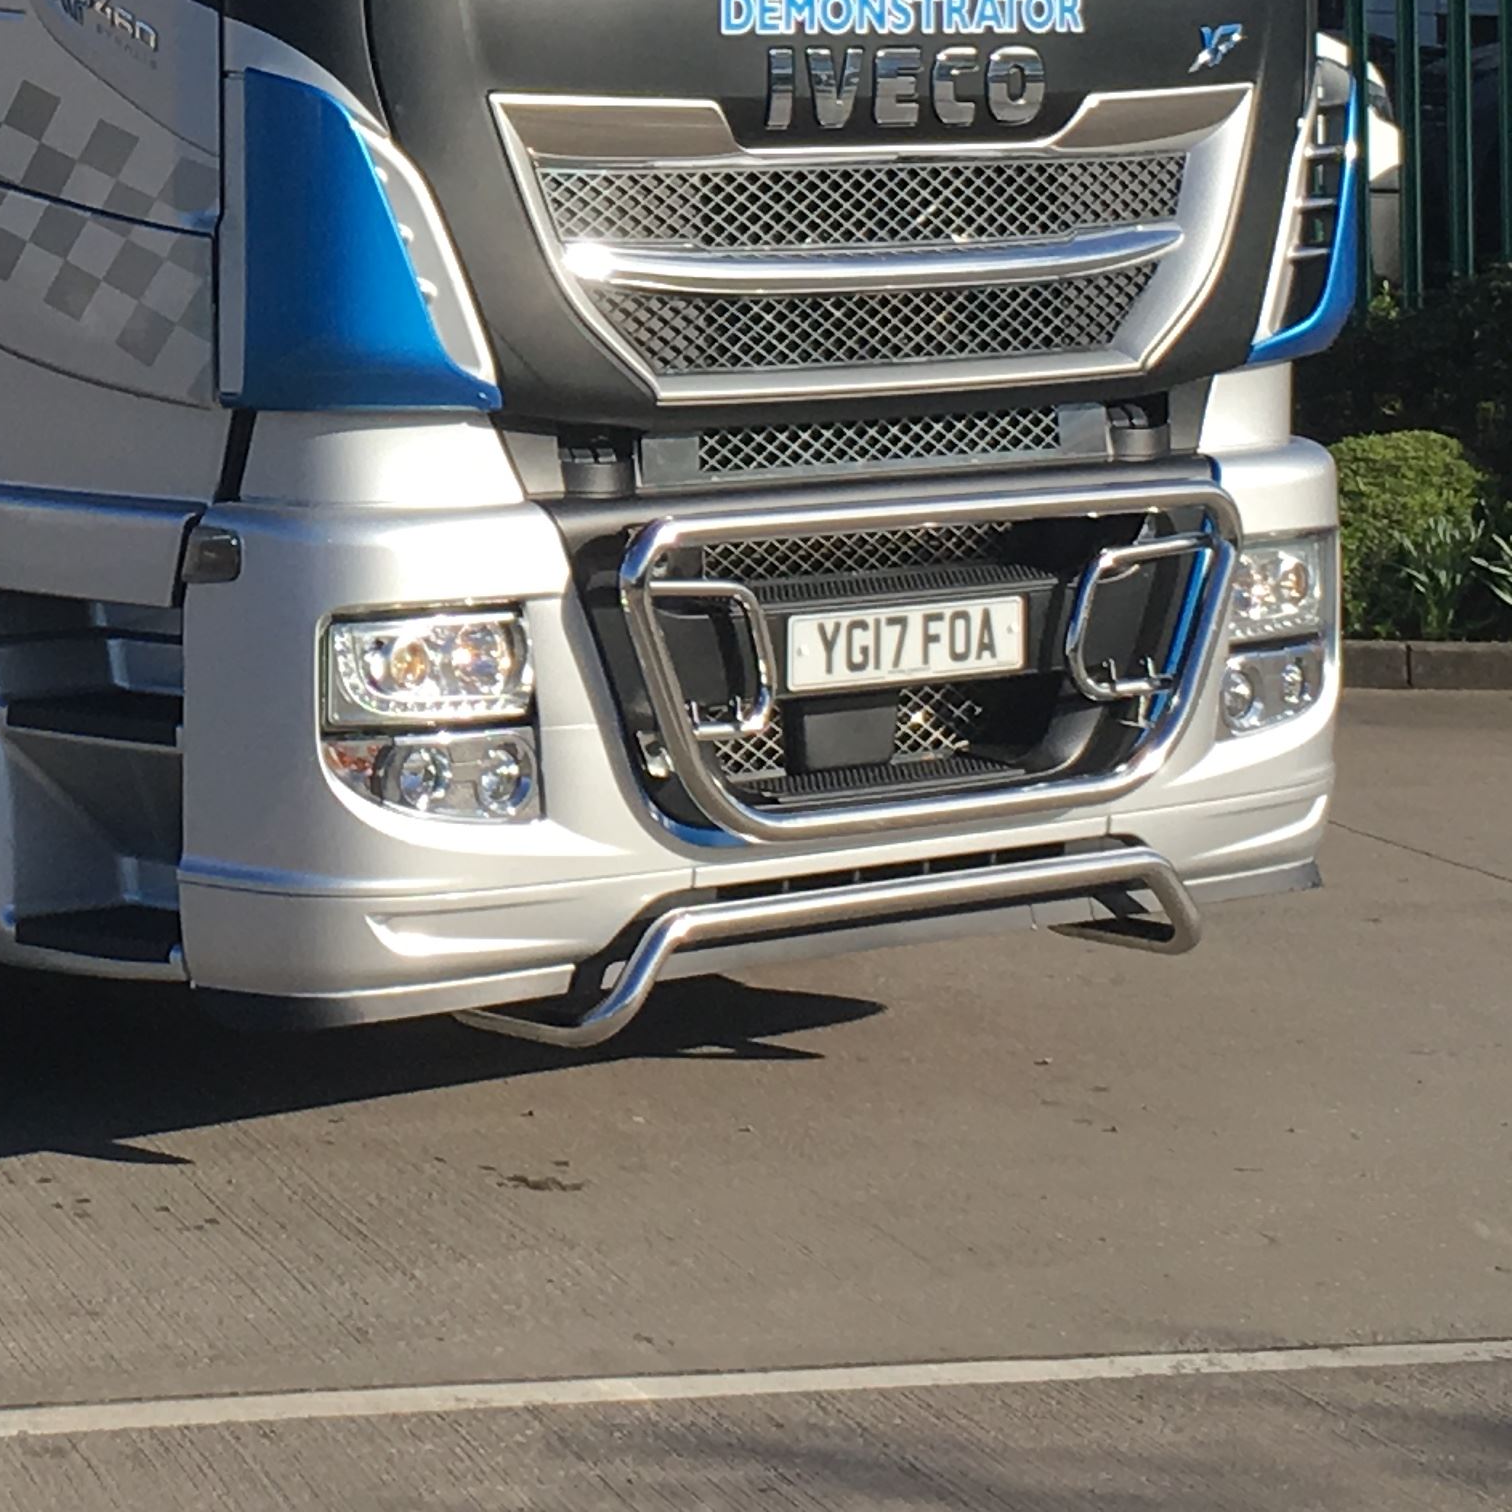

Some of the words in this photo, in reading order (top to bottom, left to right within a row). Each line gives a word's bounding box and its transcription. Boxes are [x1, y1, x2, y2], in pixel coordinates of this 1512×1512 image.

[765, 44, 1046, 130] IVECO
[817, 614, 909, 675] YG17
[921, 606, 998, 666] FOA
